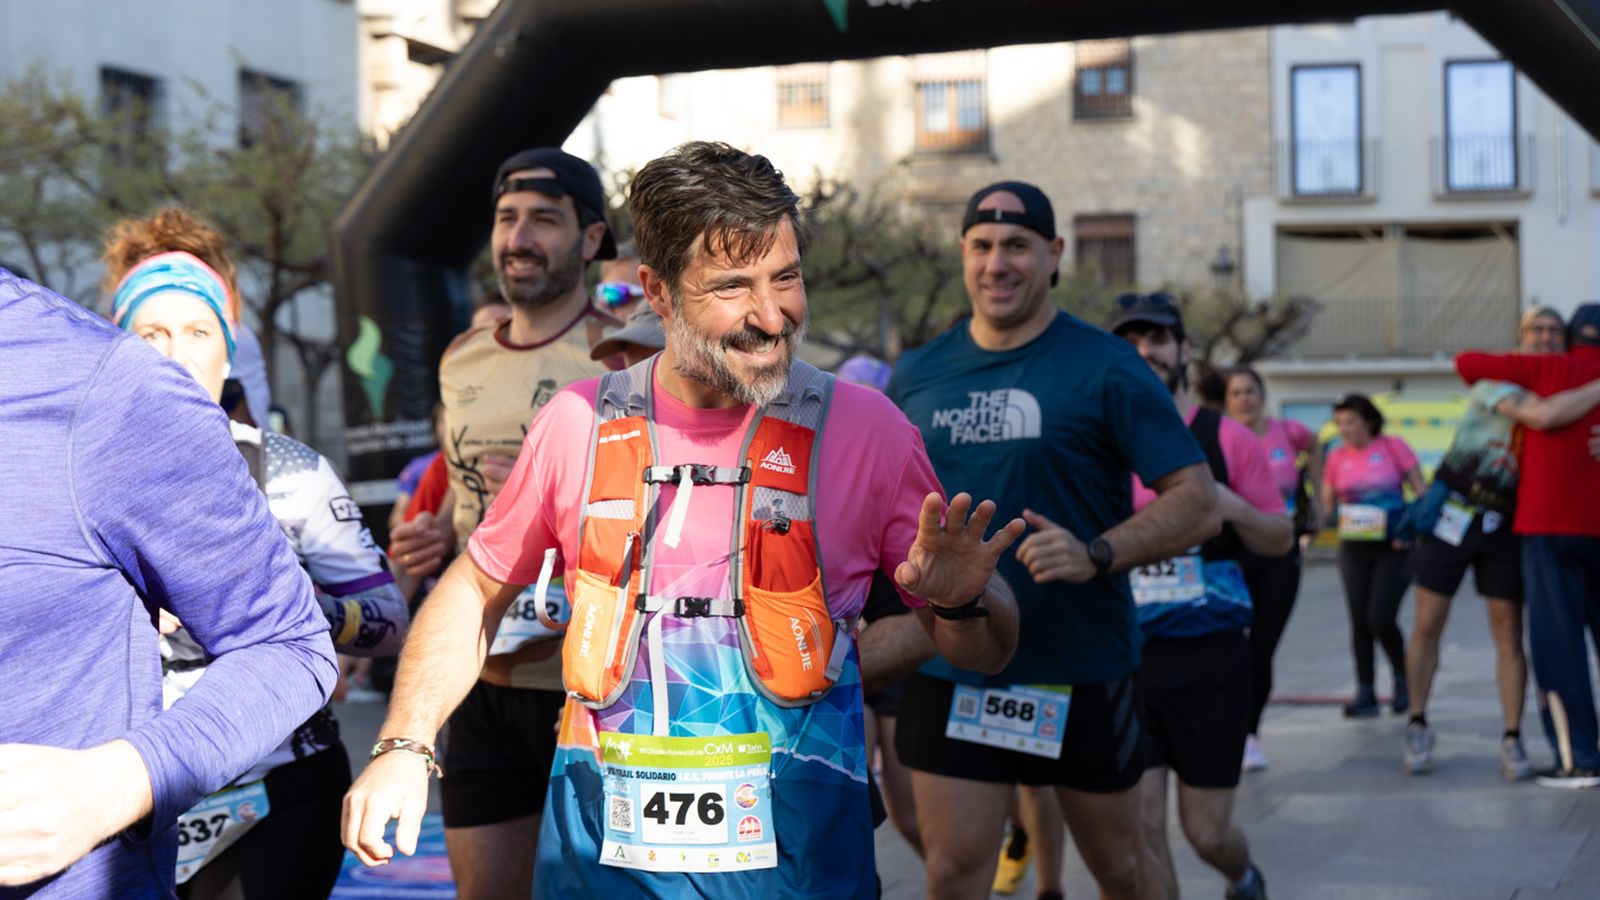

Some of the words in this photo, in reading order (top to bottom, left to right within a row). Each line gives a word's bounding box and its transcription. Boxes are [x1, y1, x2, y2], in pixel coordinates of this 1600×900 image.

[968, 390, 1007, 410] THE
[932, 407, 1005, 428] NORTH
[950, 424, 1003, 445] FACE
[760, 462, 795, 474] AONIJIE
[788, 617, 813, 672] AONIJIE
[985, 695, 1035, 722] 568
[704, 743, 734, 756] CxM
[704, 755, 734, 767] 2025
[635, 770, 677, 781] SOLIDARIO
[643, 791, 725, 826] 476
